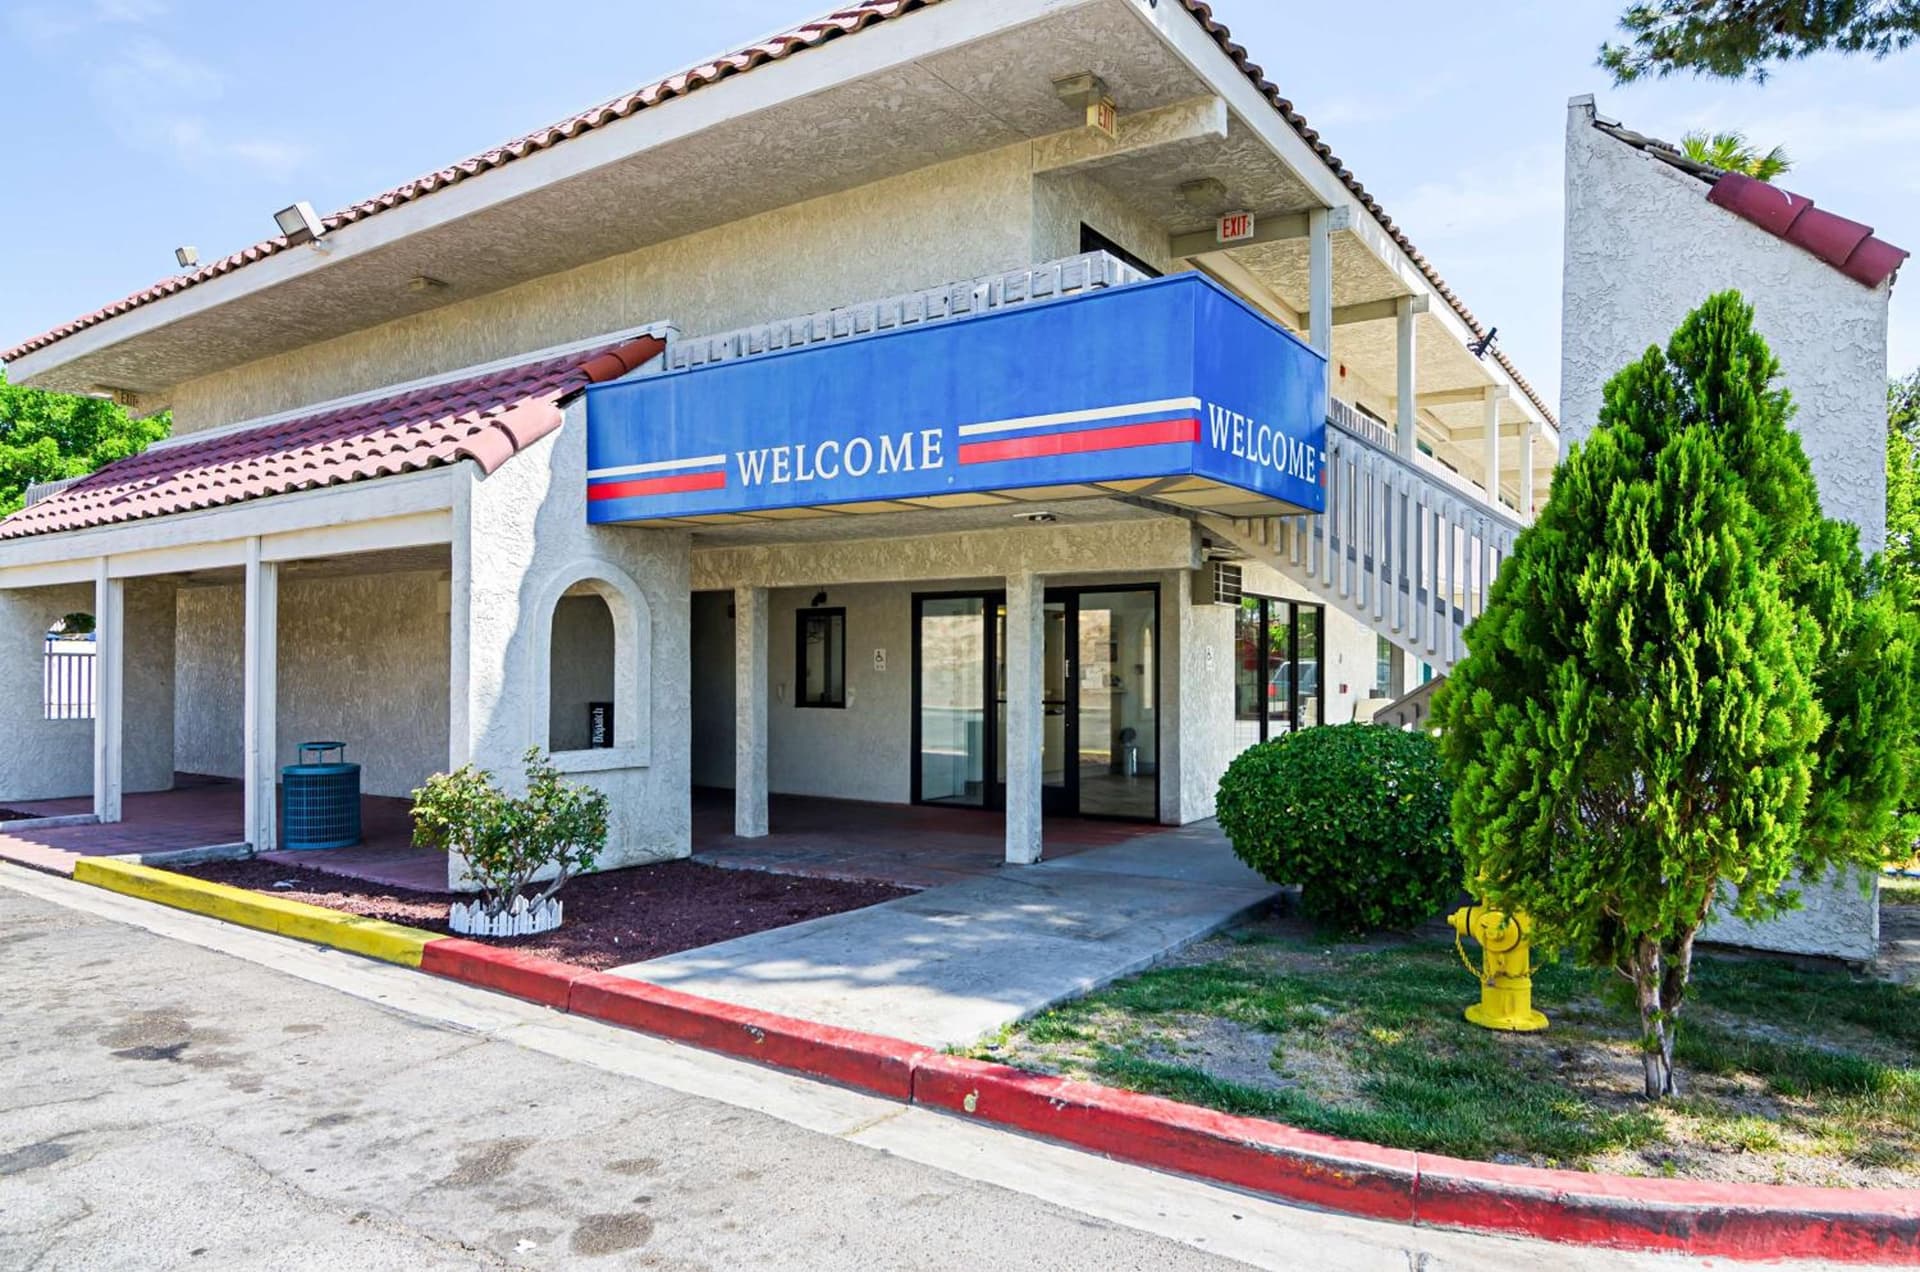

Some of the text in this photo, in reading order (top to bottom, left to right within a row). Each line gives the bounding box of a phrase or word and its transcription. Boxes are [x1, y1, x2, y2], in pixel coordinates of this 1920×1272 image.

[1098, 103, 1114, 135] EXIT
[1223, 215, 1248, 238] EXIT
[736, 428, 944, 486] WELCOME
[1207, 402, 1316, 484] WELCOME
